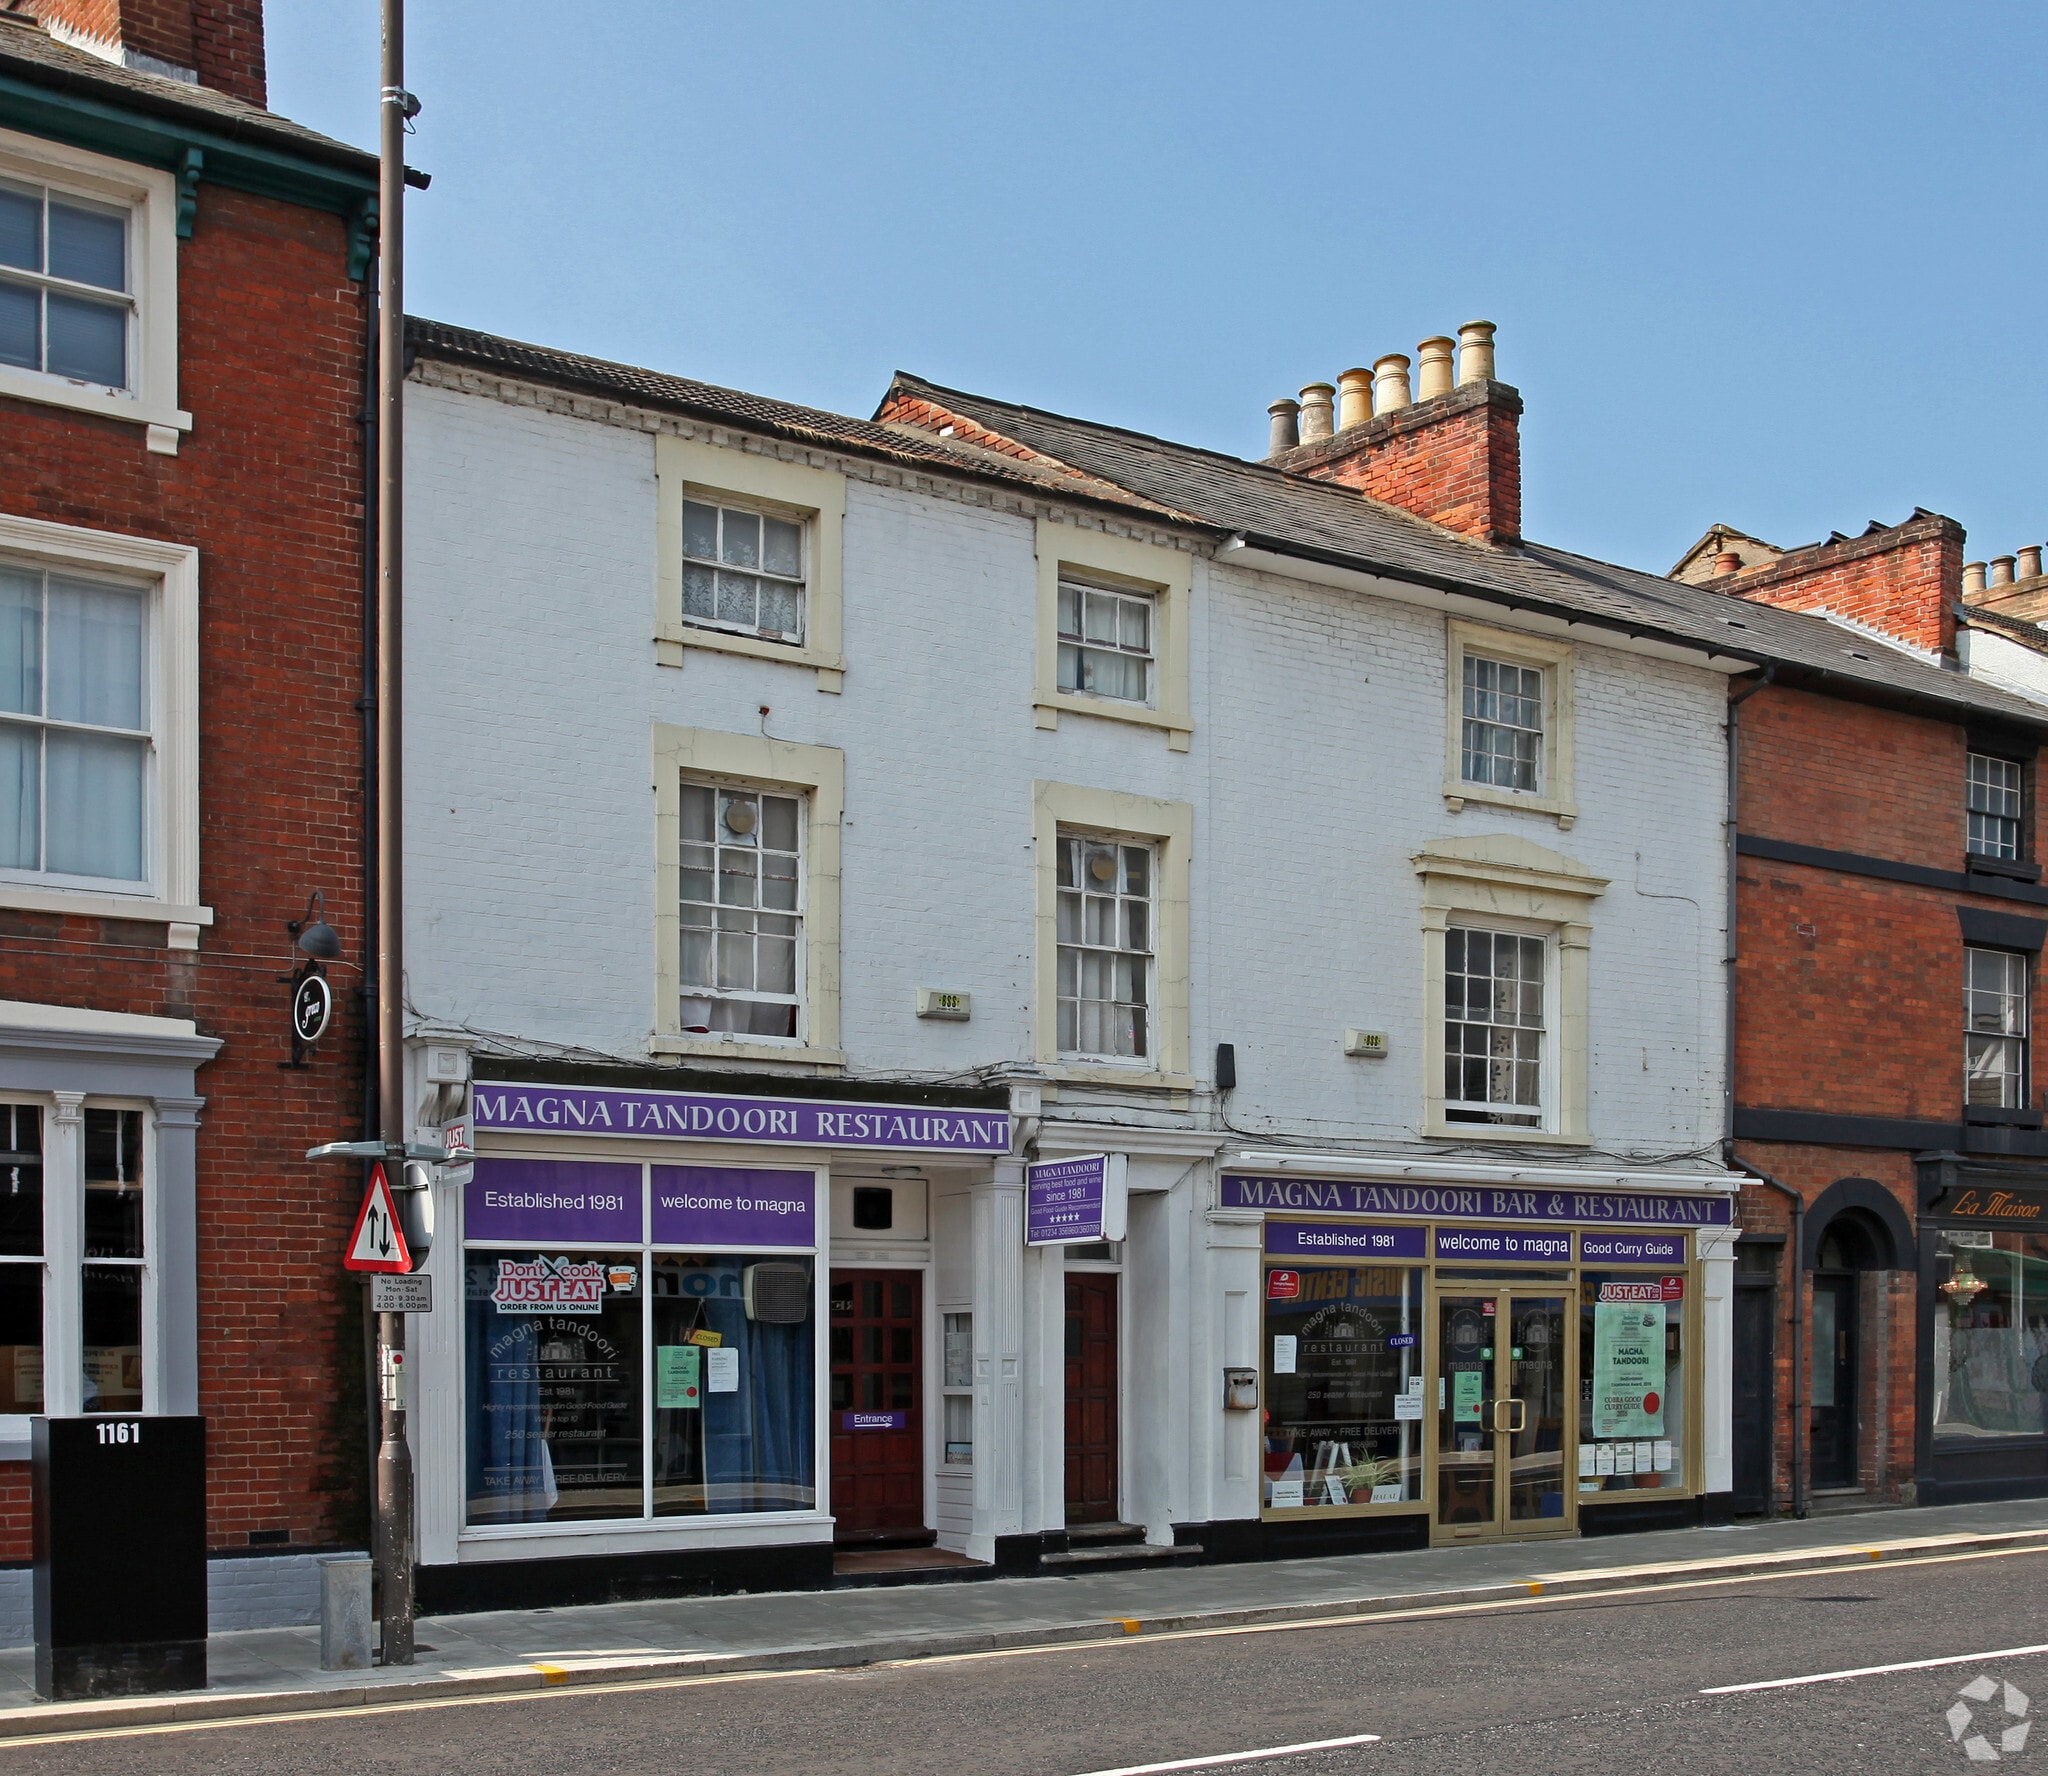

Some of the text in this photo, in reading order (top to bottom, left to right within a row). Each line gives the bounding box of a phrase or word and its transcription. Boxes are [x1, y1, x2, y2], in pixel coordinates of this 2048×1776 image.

[474, 1094, 1010, 1145] MAGNA TANDOORI RESTAURANT
[446, 1126, 464, 1149] JUST
[1035, 1162, 1100, 1178] MAGNA TANDOORI
[1031, 1182, 1050, 1190] serving
[1051, 1180, 1063, 1189] best
[1064, 1178, 1076, 1187] food
[1077, 1177, 1087, 1185] and
[485, 1191, 624, 1211] Established 1981
[1046, 1187, 1086, 1202] since 1981
[1238, 1180, 1716, 1221] MAGNA TANDOORI BAR & RESTAURANT
[660, 1194, 806, 1215] welcome to magna
[1950, 1190, 2041, 1217] La Maison
[1041, 1228, 1057, 1237] 01234
[1298, 1232, 1395, 1247] Established 1981
[1439, 1233, 1568, 1255] welcome to magna
[1584, 1241, 1673, 1257] Good Curry Guide
[502, 1261, 601, 1277] Don't cook
[394, 1278, 423, 1286] Loading
[500, 1279, 601, 1300] JUST EAT
[1602, 1286, 1630, 1299] JUST
[1631, 1286, 1652, 1299] EAT
[500, 1303, 600, 1311] ORDER FROM US ONLINE
[1301, 1302, 1386, 1337] magna tandoori
[490, 1316, 620, 1360] magna tandoori
[695, 1333, 719, 1343] CLOSED
[1390, 1336, 1414, 1346] CLOSED
[1304, 1343, 1384, 1353] restaurant
[1618, 1347, 1645, 1356] MAGNA
[1448, 1361, 1484, 1371] magna
[1519, 1360, 1553, 1372] magna
[1612, 1357, 1649, 1365] TANDOORI
[497, 1366, 612, 1380] restaurant
[556, 1387, 575, 1396] 1981
[1307, 1391, 1321, 1399] 250
[1347, 1390, 1383, 1398] restaurant
[482, 1403, 506, 1413] Highly
[566, 1401, 587, 1410] Good
[587, 1401, 607, 1409] Food
[607, 1401, 628, 1409] Guide
[854, 1414, 894, 1424] Entrance
[96, 1422, 139, 1444] 1161
[504, 1430, 525, 1440] 250
[559, 1428, 607, 1438] restaurant
[1310, 1428, 1332, 1437] AWAY
[1340, 1427, 1361, 1436] FREE
[1364, 1426, 1402, 1436] DELIVERY
[484, 1476, 511, 1486] TAKE
[514, 1475, 540, 1485] AWAY
[578, 1472, 627, 1482] DELIVERY
